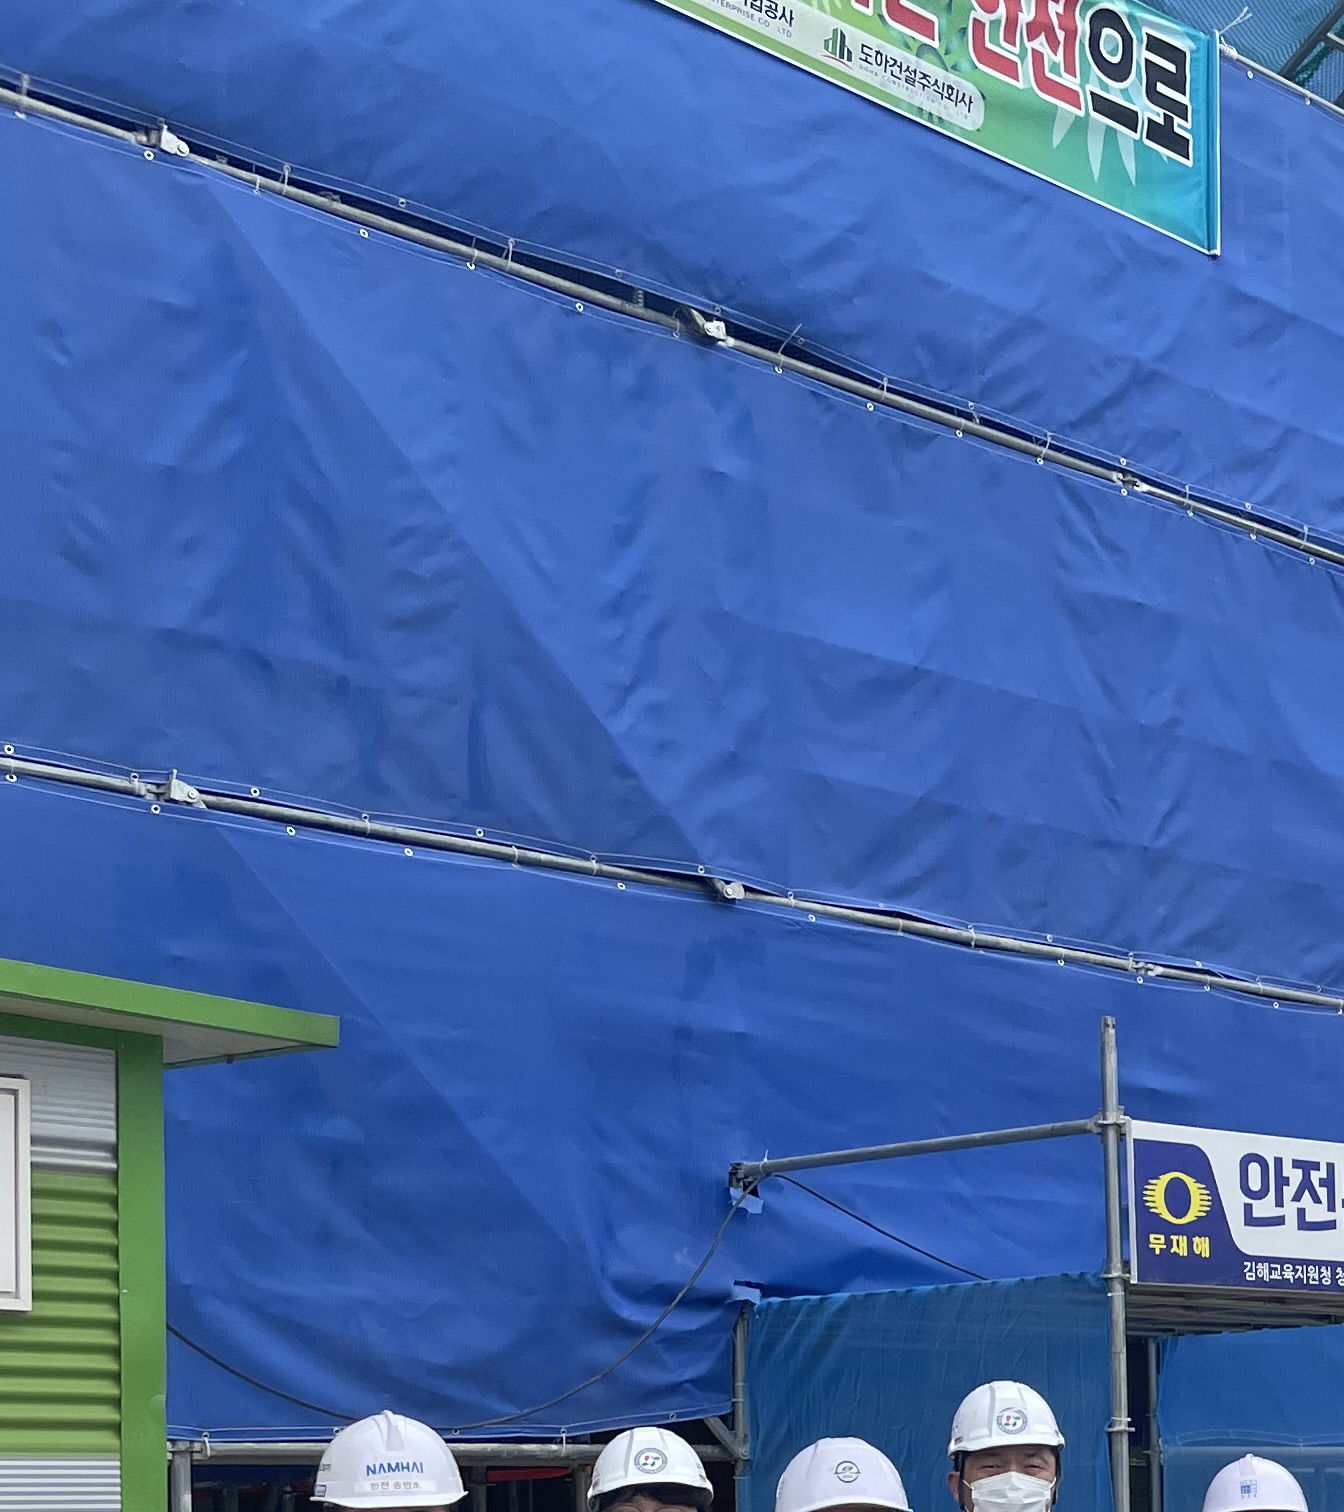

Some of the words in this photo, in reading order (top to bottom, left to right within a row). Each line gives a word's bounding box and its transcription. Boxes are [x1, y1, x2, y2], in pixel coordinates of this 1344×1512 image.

[859, 43, 974, 113] 도하건설주식회사
[1243, 1261, 1331, 1285] 김해교육지원청
[366, 1461, 424, 1476] NAMHAI
